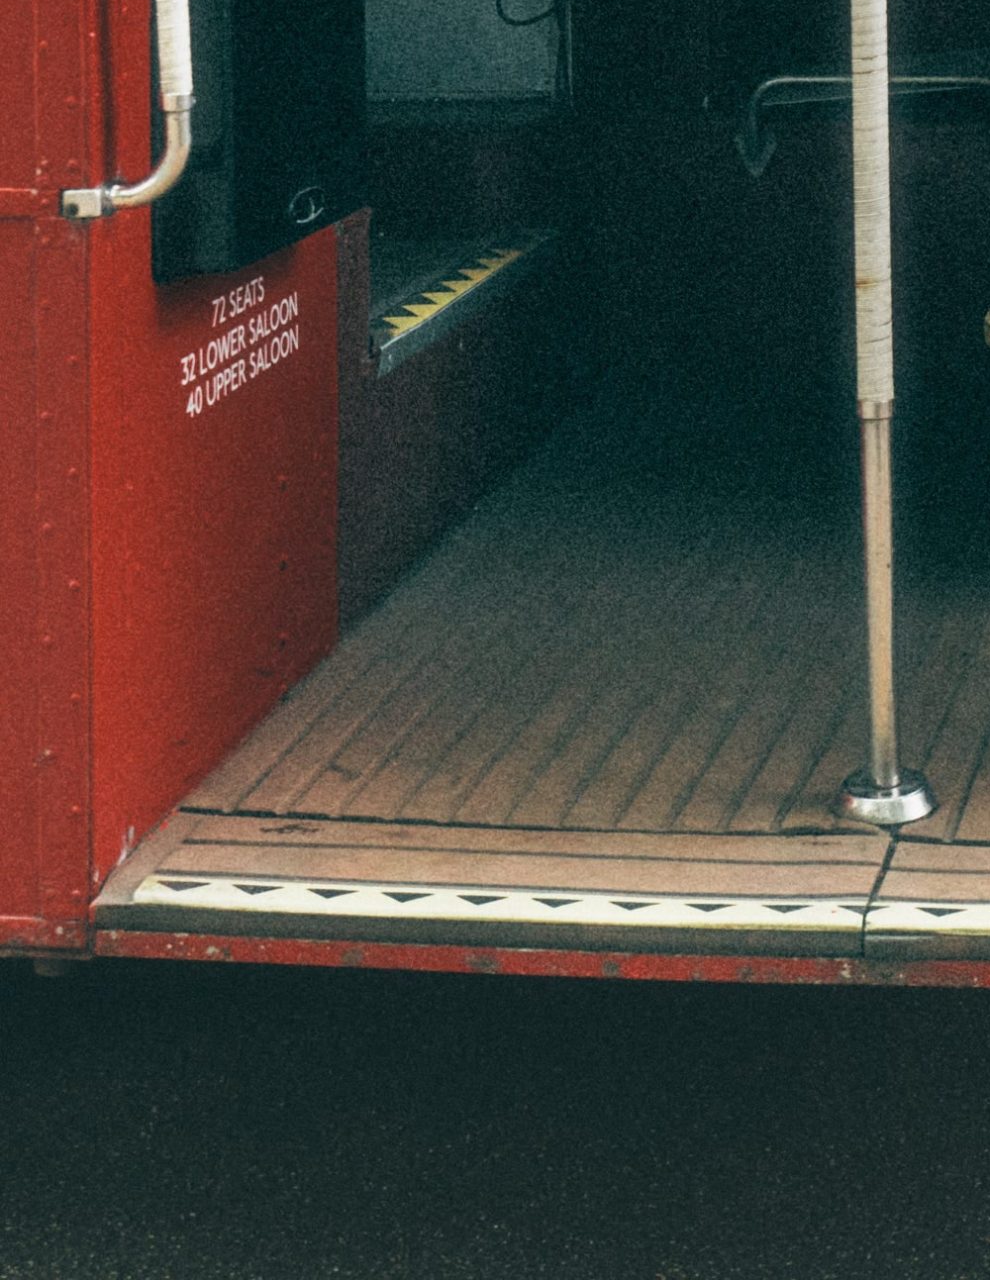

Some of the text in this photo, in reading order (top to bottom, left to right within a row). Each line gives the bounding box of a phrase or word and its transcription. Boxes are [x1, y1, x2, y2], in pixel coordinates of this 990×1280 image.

[181, 291, 299, 386] 32 LOWER SALOON
[212, 276, 265, 328] 72 SEATS
[186, 324, 299, 418] 40 UPPER SALOON
